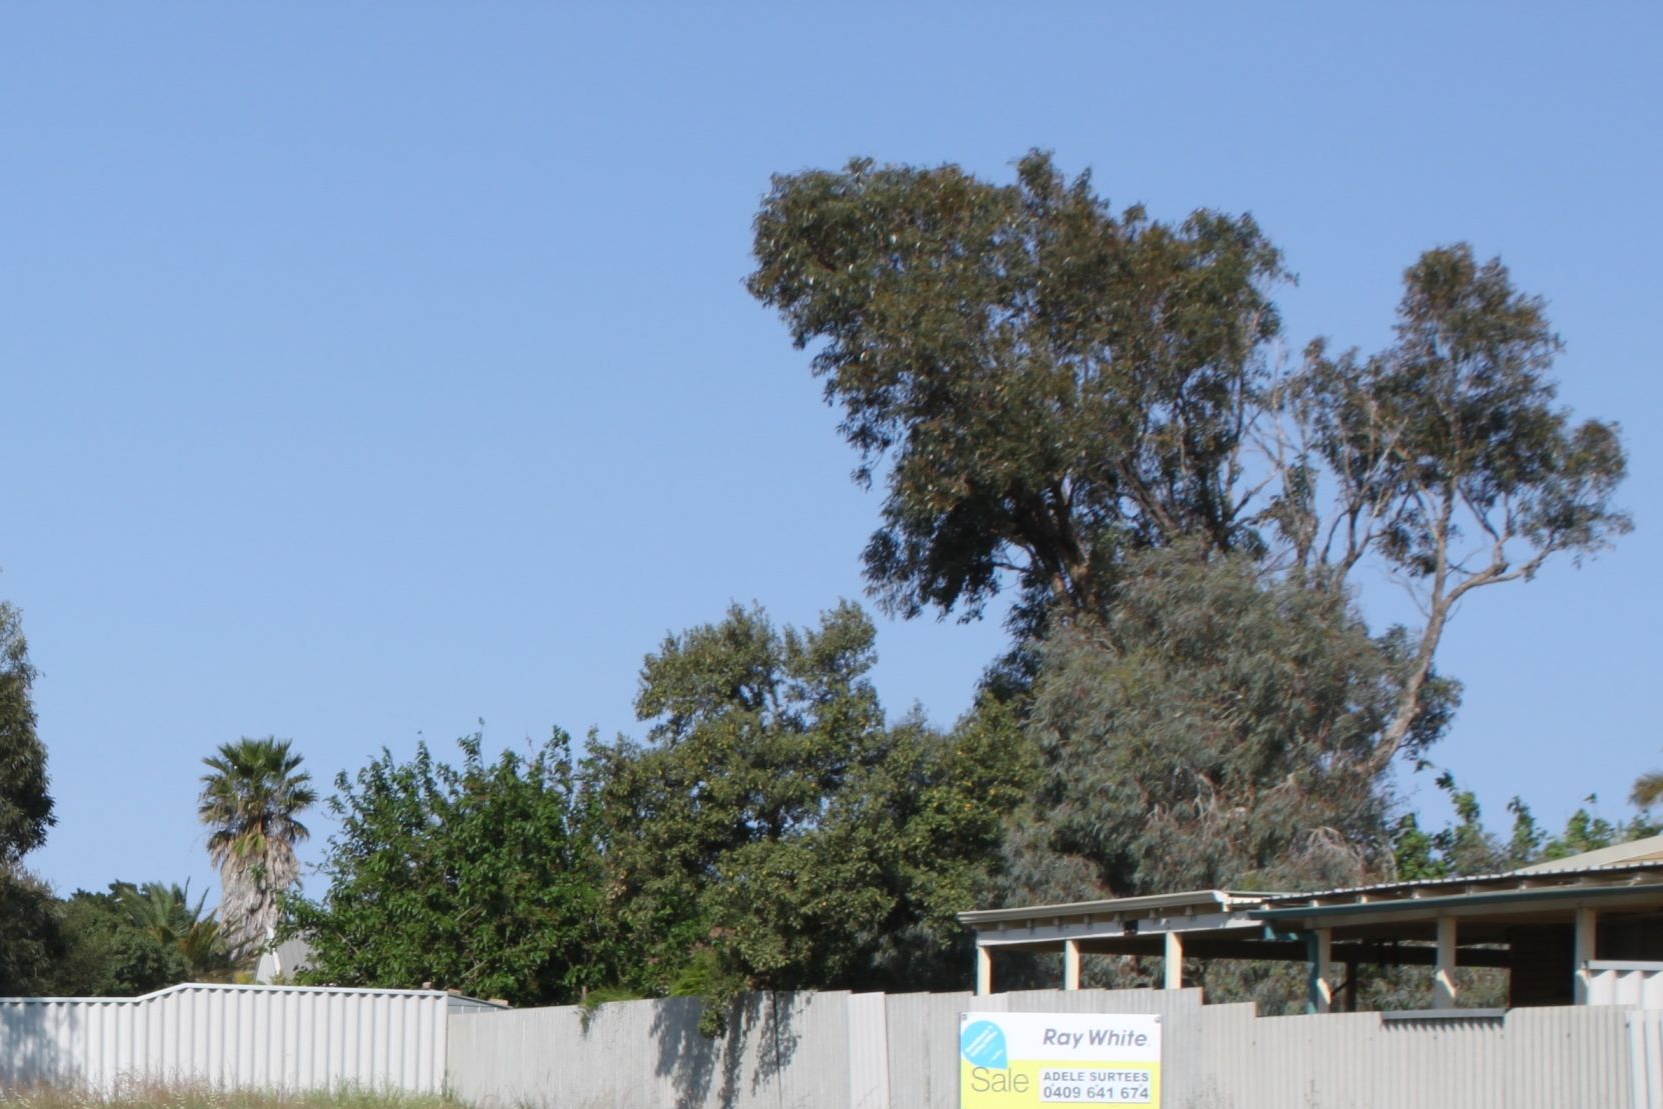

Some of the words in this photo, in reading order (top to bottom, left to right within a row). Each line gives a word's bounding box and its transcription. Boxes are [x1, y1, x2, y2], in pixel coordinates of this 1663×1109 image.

[1043, 1028, 1083, 1049] Ray
[1089, 1029, 1148, 1047] White
[971, 1066, 1030, 1093] Sale
[1043, 1071, 1085, 1082] ADELE
[1089, 1072, 1149, 1082] SURTEES
[1043, 1086, 1081, 1099] 0409
[1087, 1087, 1114, 1099] 641
[1120, 1087, 1149, 1099] 674
